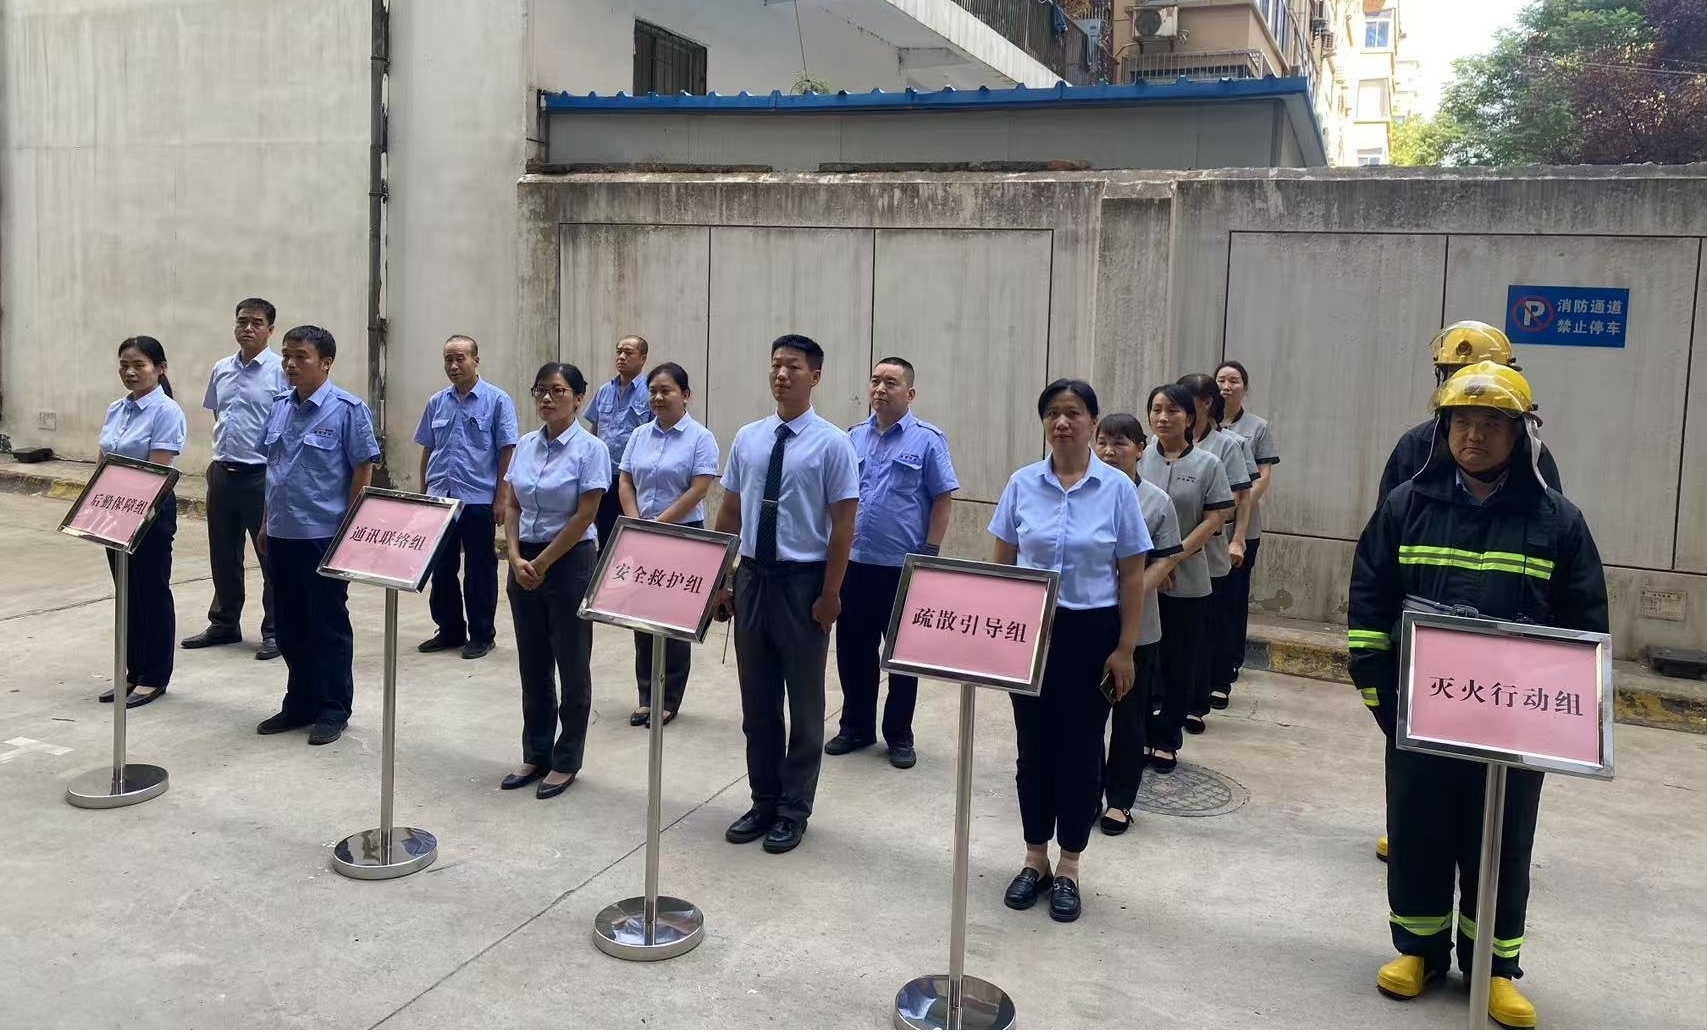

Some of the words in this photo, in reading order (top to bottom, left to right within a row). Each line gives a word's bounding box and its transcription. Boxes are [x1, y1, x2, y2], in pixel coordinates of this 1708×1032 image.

[1557, 298, 1624, 315] 消防通道
[1557, 320, 1621, 336] 禁止停车
[90, 493, 149, 515] 后勤保障组
[349, 526, 427, 550] 通讯联络组
[612, 563, 704, 594] 安全救护组
[912, 607, 1027, 643] 疏散引导组
[1429, 676, 1584, 716] 灭火行动组
